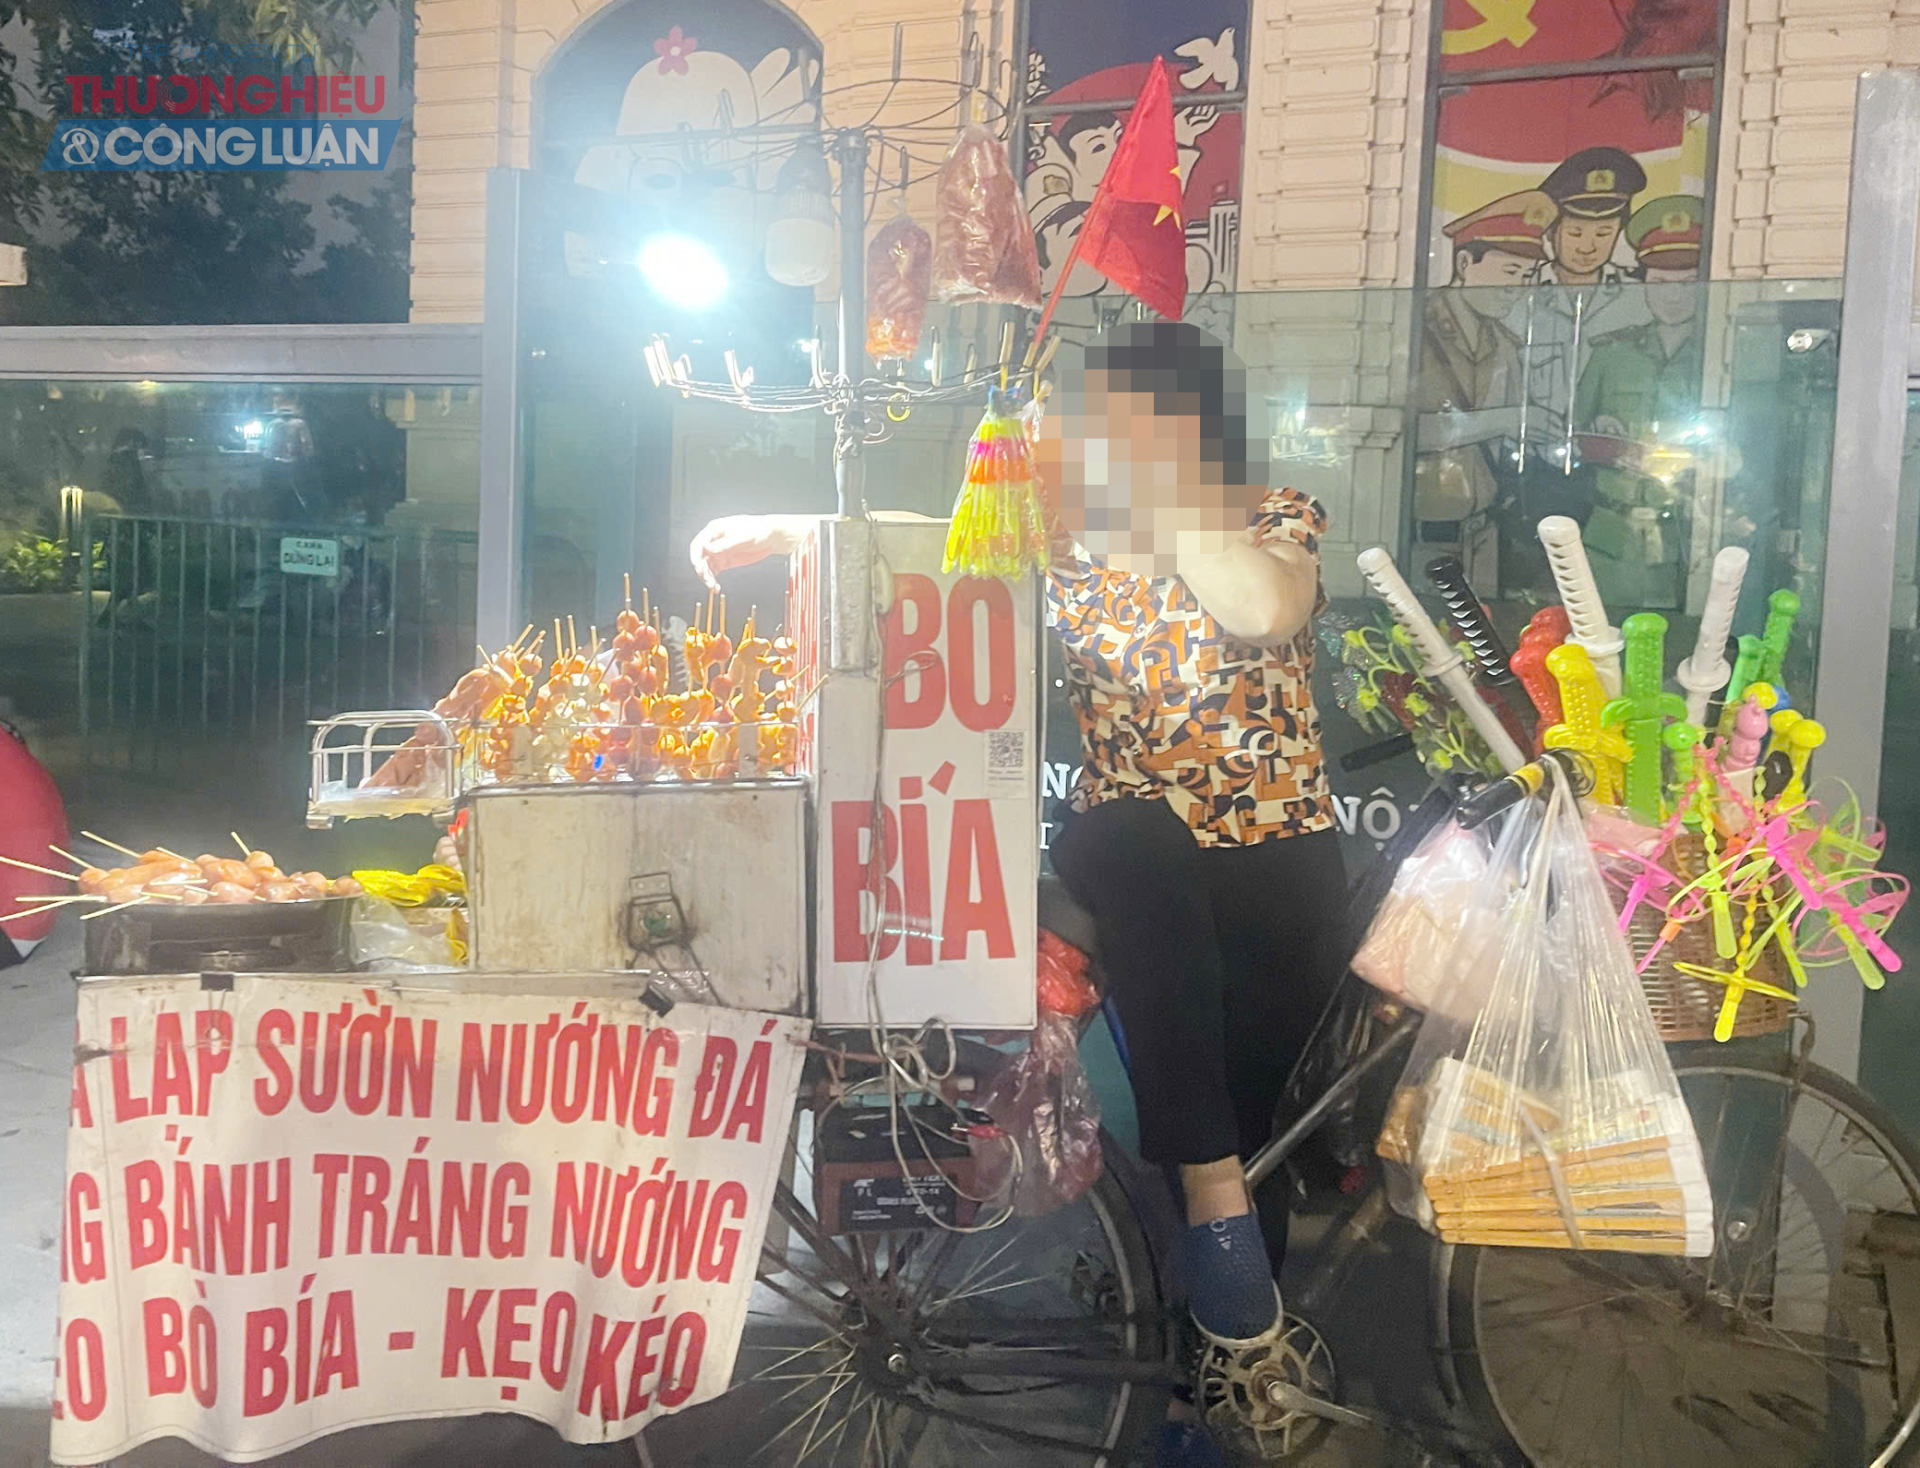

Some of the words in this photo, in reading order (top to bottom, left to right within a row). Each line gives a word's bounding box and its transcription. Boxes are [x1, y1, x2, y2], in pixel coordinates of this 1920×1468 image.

[1330, 786, 1420, 852] NỘ
[253, 988, 439, 1119] SƯỜN
[456, 1001, 680, 1139] NƯỚNG
[687, 1019, 778, 1144] ĐÁ
[60, 1172, 107, 1285] G
[124, 1136, 292, 1277] BÁNH
[313, 1136, 531, 1260] TRÁNG
[550, 1156, 749, 1289] NƯỚNG
[142, 1279, 219, 1410] BÒ
[243, 1273, 360, 1418] BÍA
[441, 1288, 578, 1402] KẸO
[577, 1294, 708, 1422] KÉO
